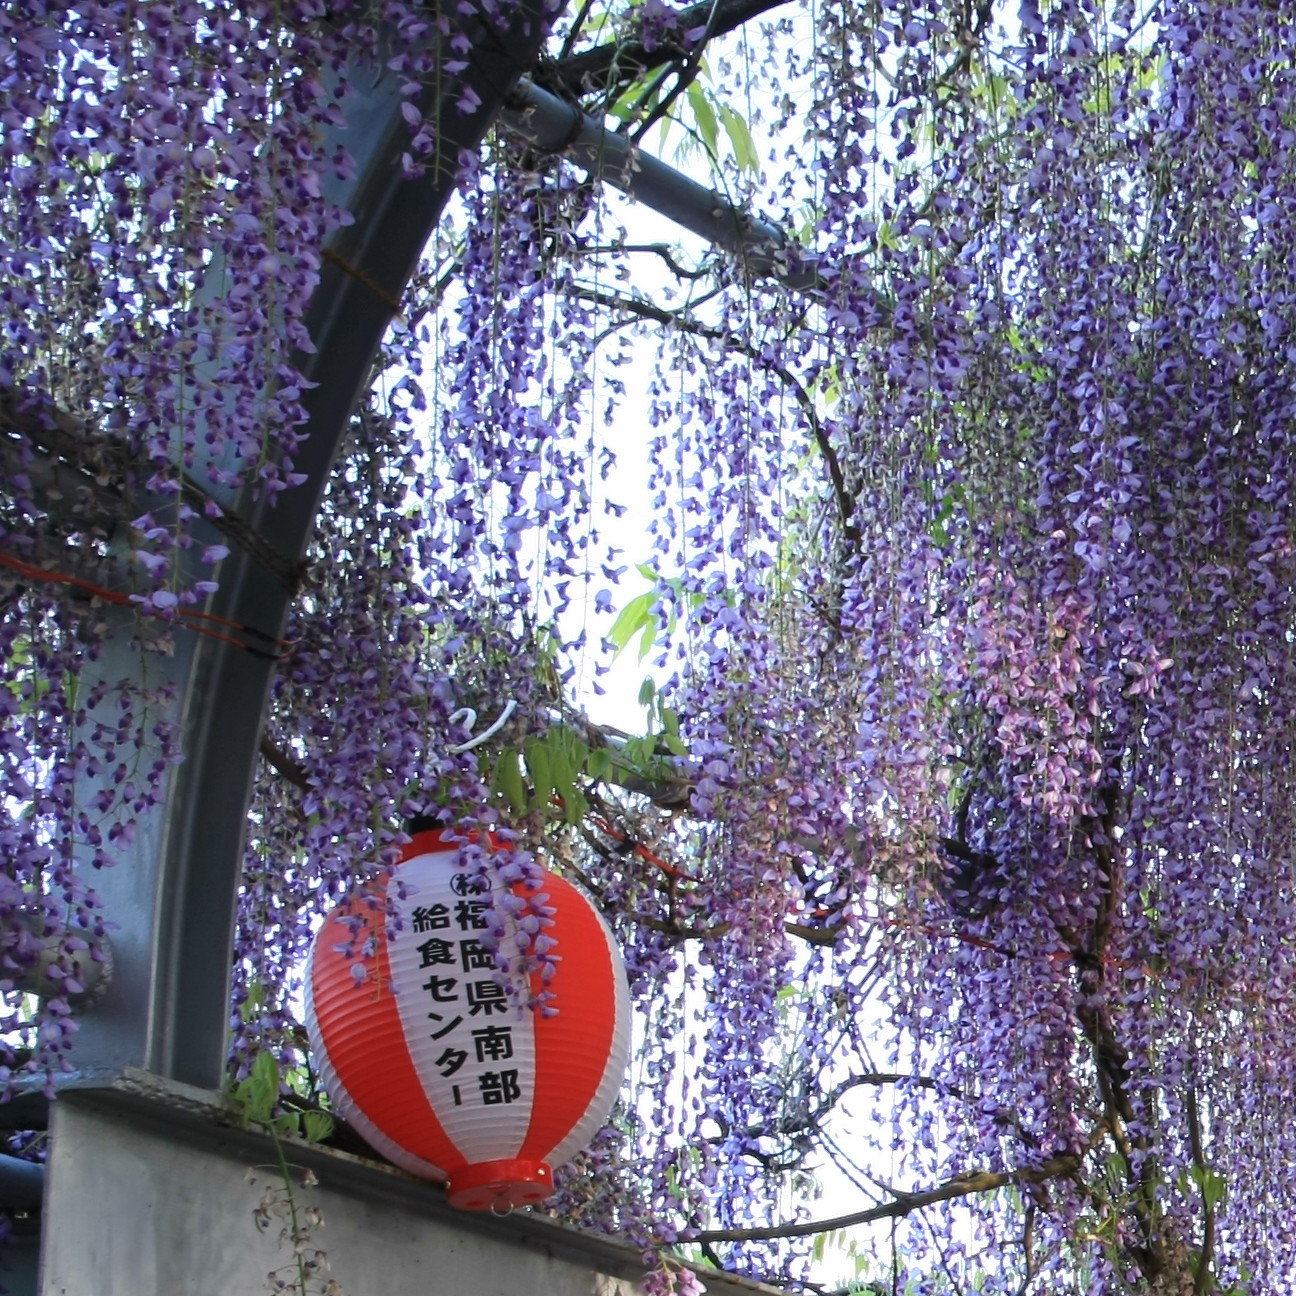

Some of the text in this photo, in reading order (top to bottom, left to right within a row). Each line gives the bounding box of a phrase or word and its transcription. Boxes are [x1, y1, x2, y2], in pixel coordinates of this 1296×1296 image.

[411, 903, 469, 1107] 給食センター
